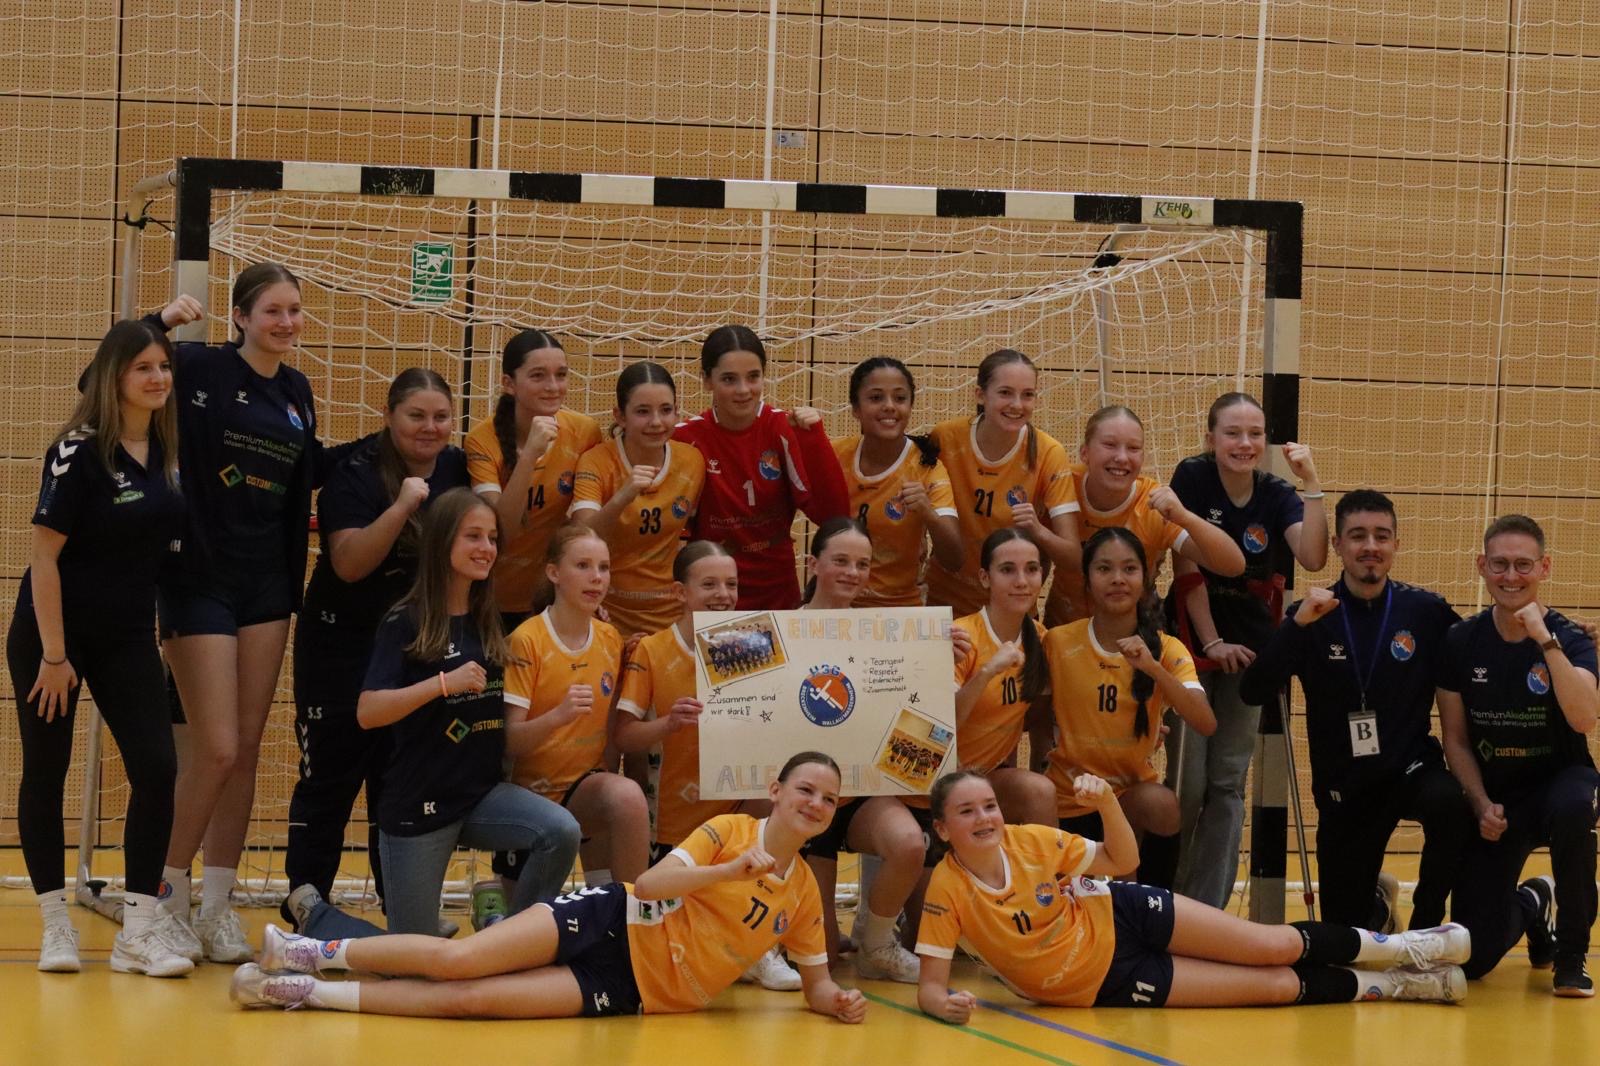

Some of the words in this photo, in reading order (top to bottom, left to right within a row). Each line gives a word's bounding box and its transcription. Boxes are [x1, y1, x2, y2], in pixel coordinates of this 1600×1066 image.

[528, 484, 545, 511] 14
[743, 479, 756, 507] 1
[975, 488, 994, 518] 21
[640, 507, 661, 535] 33
[787, 617, 852, 641] EINER
[858, 613, 900, 643] FÜR
[902, 617, 952, 641] ALLE
[869, 667, 898, 678] Respekt
[707, 694, 757, 704] Zusammen
[761, 693, 776, 701] sind
[1002, 676, 1018, 706] 10
[1097, 683, 1118, 713] 18
[1356, 722, 1373, 741] B
[423, 801, 438, 816] EC
[566, 917, 580, 934] 77
[742, 896, 769, 931] 77
[1012, 909, 1032, 936] 11
[1131, 979, 1157, 1004] 11
